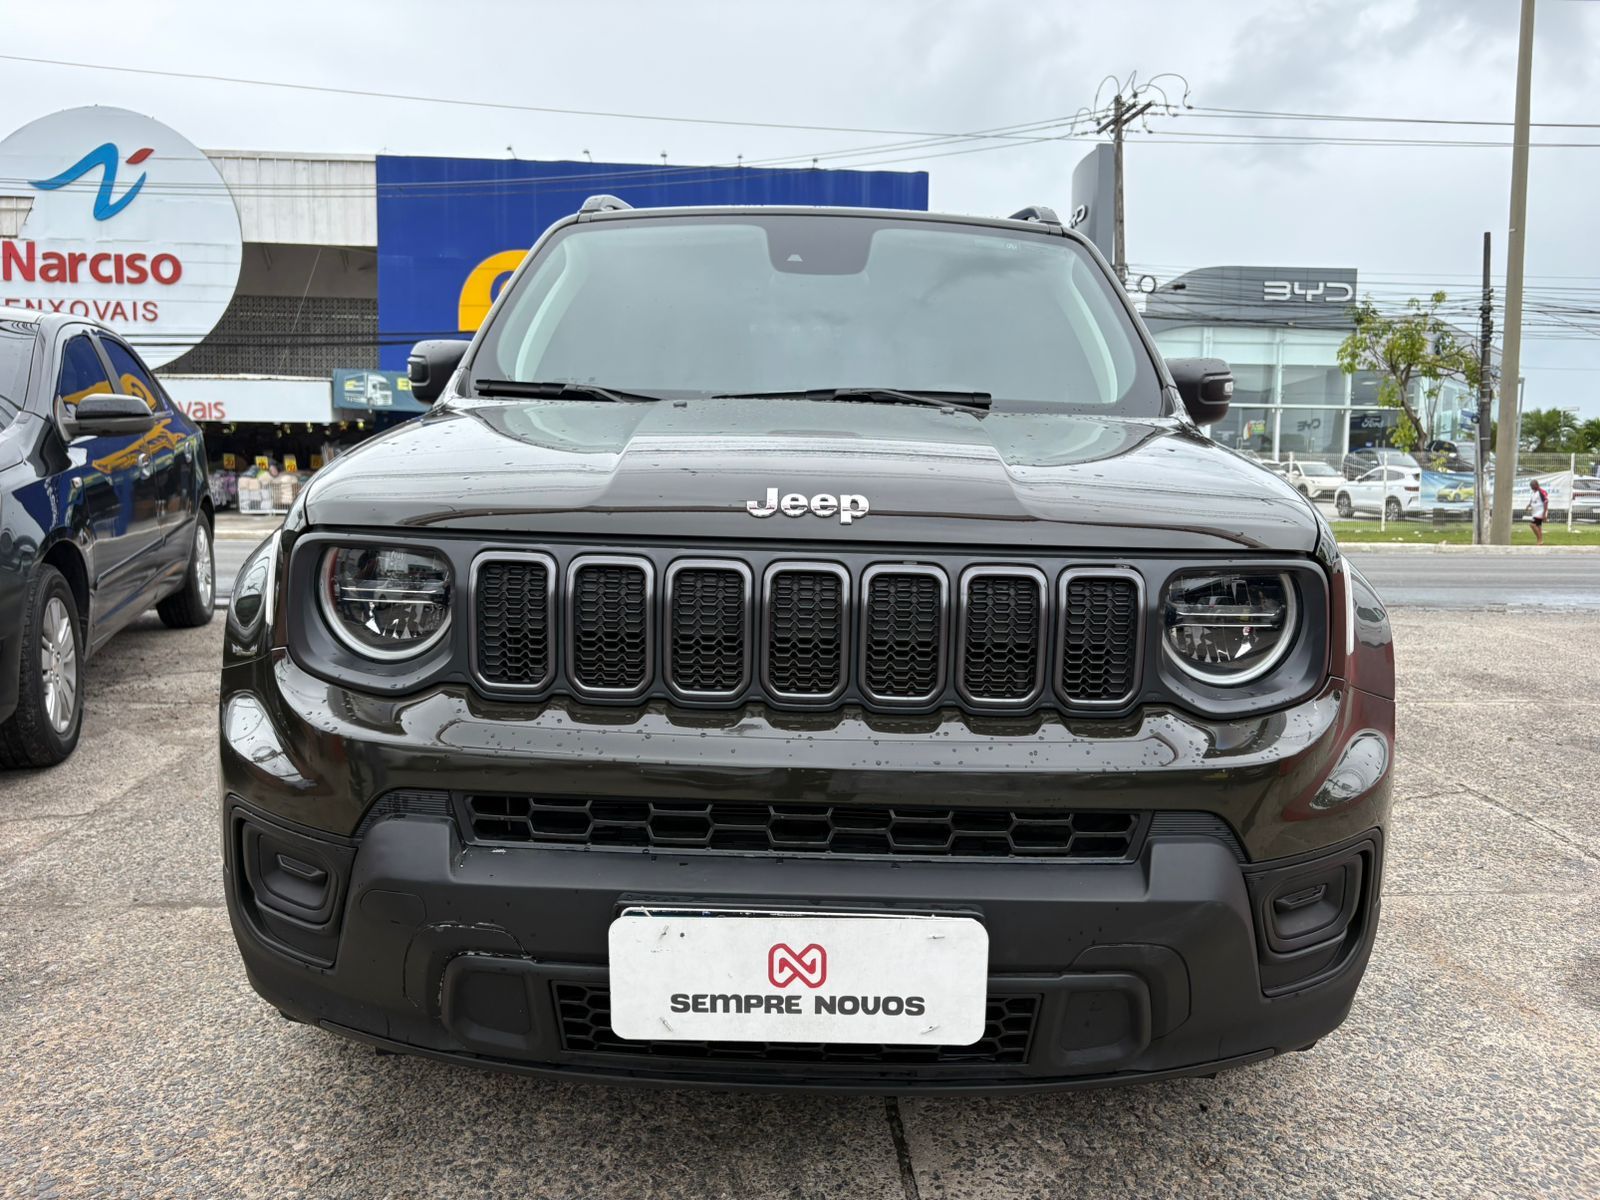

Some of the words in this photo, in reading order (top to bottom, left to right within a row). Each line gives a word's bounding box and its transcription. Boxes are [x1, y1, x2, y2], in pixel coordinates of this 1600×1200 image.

[2, 240, 182, 285] Narciso
[1263, 280, 1354, 302] BYD
[746, 487, 870, 525] Jeep
[670, 993, 802, 1014] SEMPRE
[814, 995, 926, 1016] NOVOS
